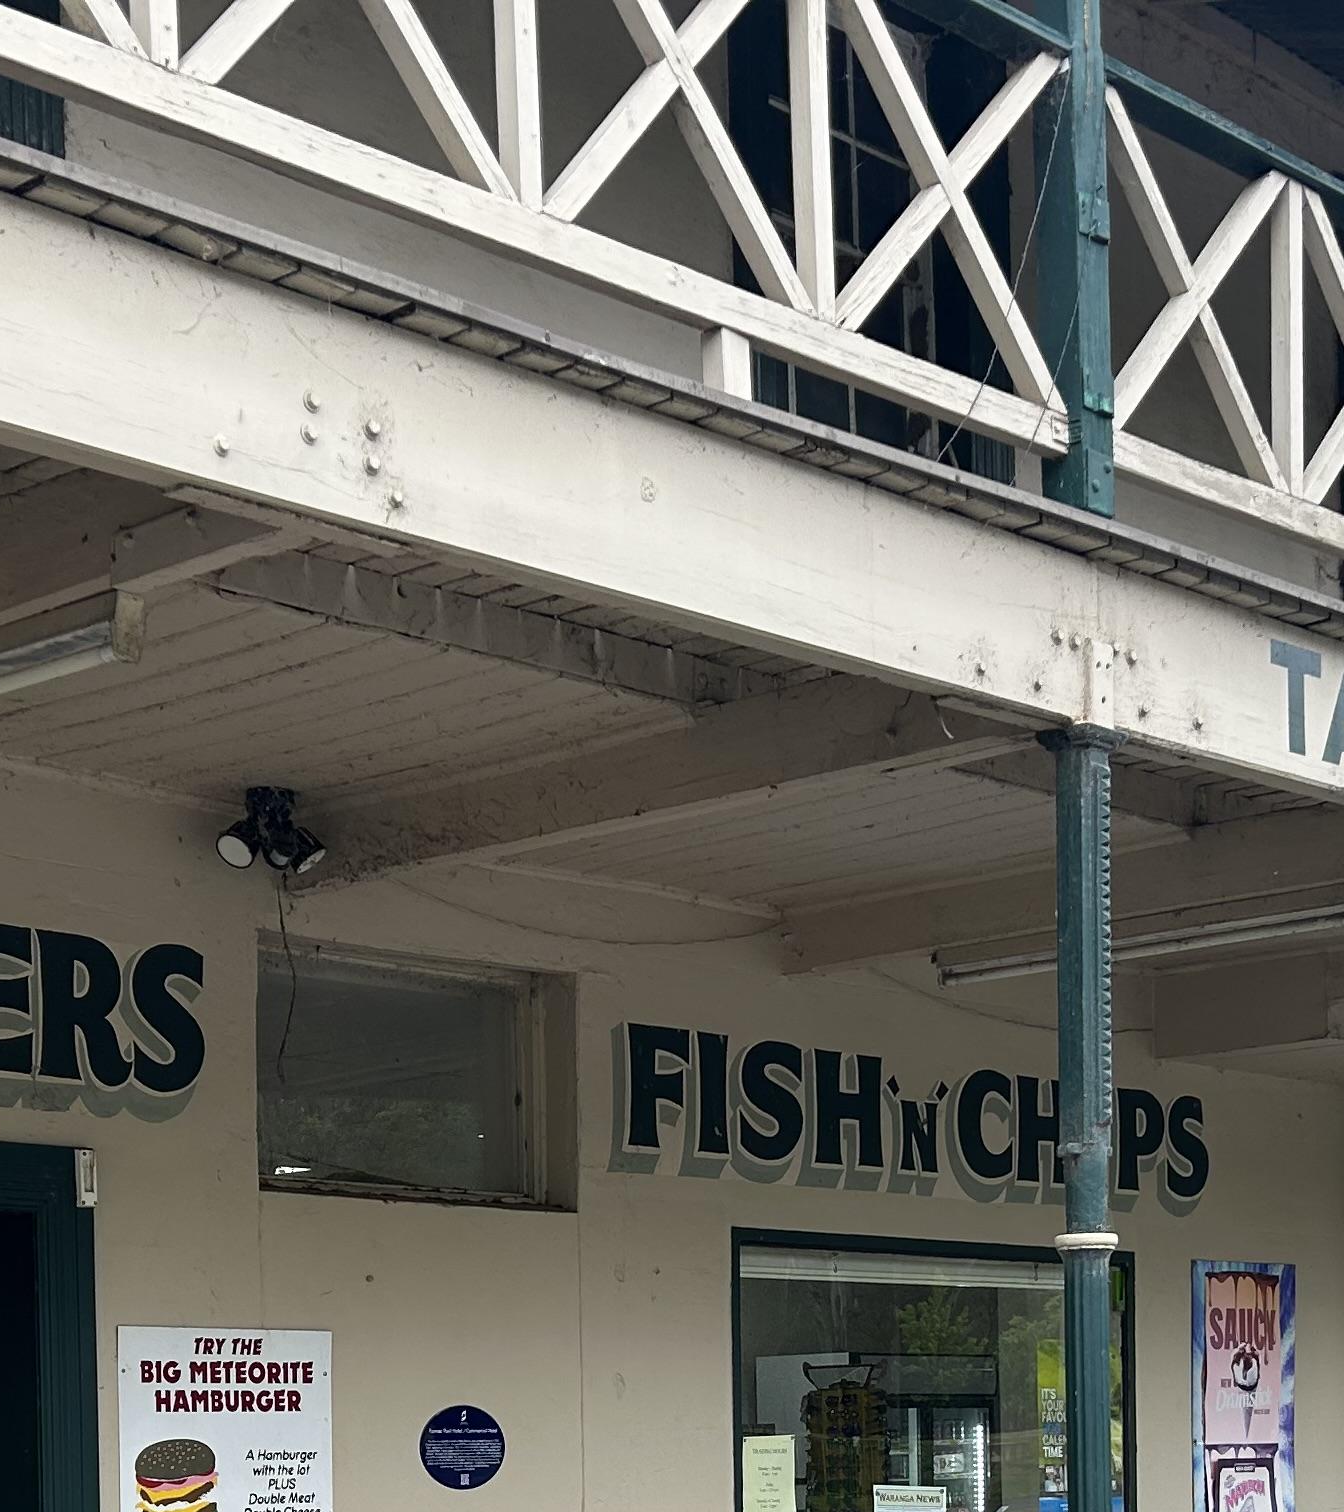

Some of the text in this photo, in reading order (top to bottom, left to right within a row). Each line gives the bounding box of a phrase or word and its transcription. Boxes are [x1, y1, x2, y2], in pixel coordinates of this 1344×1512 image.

[954, 1067, 1212, 1200] CHPS
[1209, 1306, 1277, 1351] SAUCY
[193, 1337, 264, 1356] TRY THE
[140, 1360, 314, 1385] BIG METEORITE
[154, 1389, 302, 1413] HAMBURGER
[245, 1449, 318, 1464] A Hamburger
[252, 1464, 310, 1477] with the lot
[267, 1477, 296, 1491] PLUS
[248, 1492, 316, 1506] Double Meat
